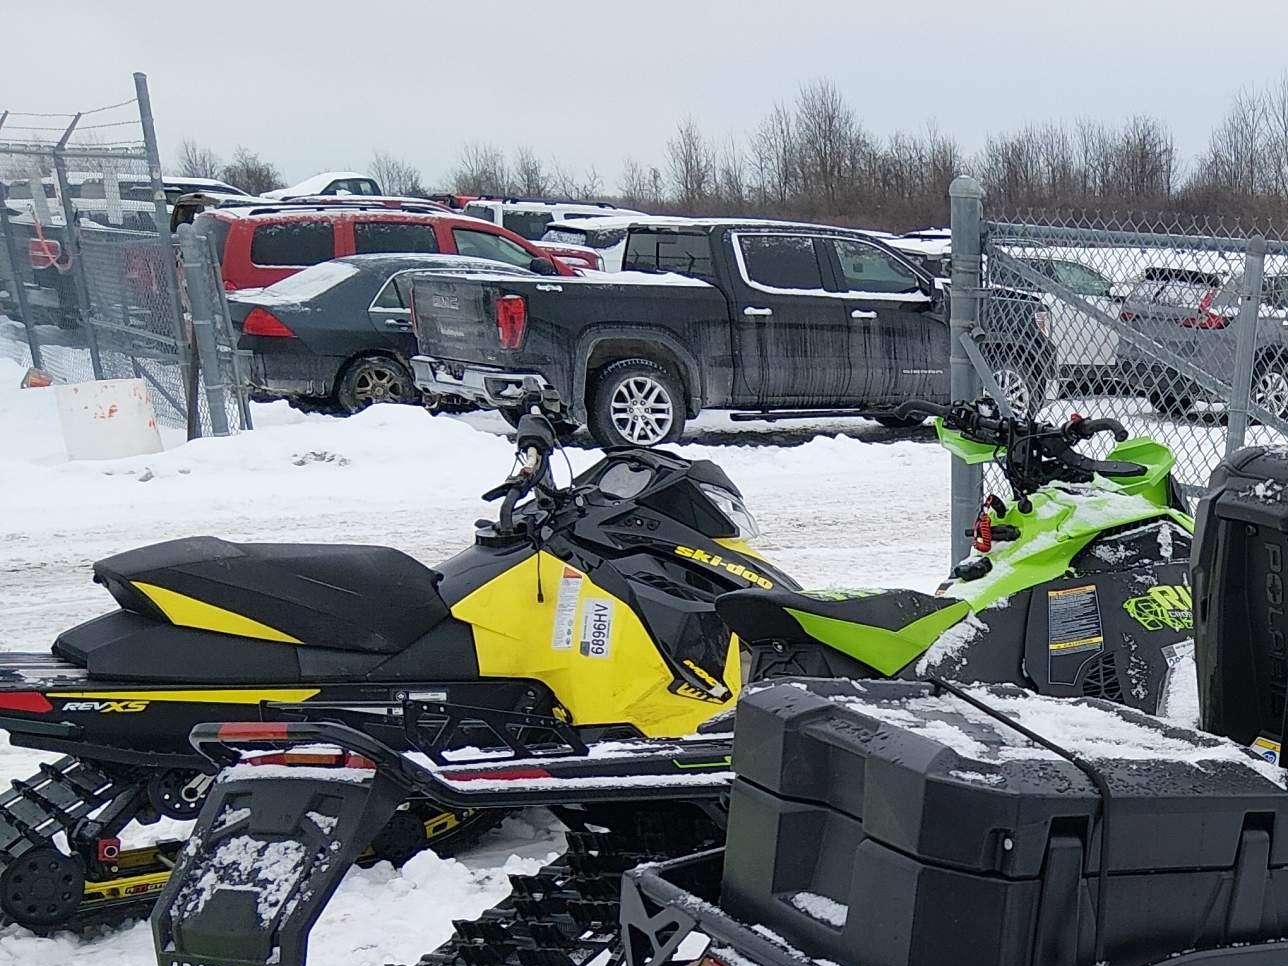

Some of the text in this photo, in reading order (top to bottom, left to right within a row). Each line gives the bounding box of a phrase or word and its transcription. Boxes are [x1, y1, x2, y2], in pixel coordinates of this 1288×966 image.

[674, 546, 774, 590] ski-doo
[1147, 585, 1193, 611] RI
[591, 603, 608, 655] 6896HV
